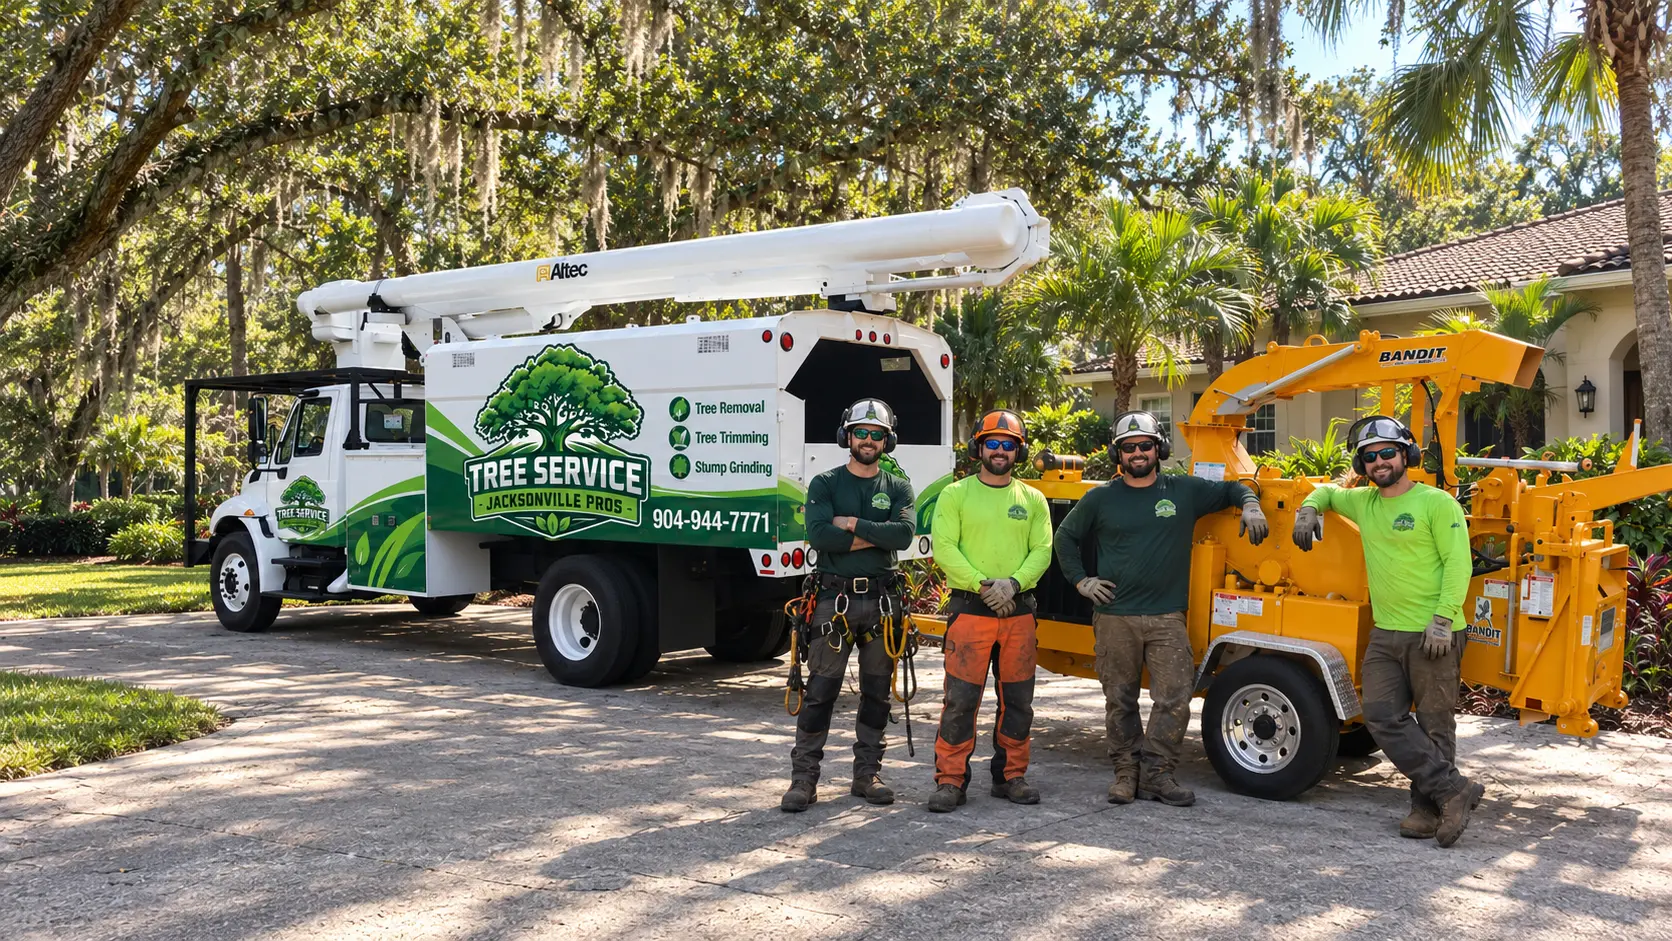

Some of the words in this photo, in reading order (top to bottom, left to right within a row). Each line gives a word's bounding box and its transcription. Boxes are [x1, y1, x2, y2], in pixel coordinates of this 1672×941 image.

[550, 262, 588, 281] Altec
[1379, 347, 1447, 362] BANDIT
[695, 402, 717, 414] Tree
[720, 400, 765, 414] Removal
[695, 431, 717, 443] Tree
[720, 431, 769, 446] Trimming
[469, 457, 527, 493] TREE
[533, 456, 642, 496] SERVICE
[695, 461, 727, 476] Stump
[729, 461, 773, 477] Grinding
[486, 492, 581, 510] JACKSONVILLE
[586, 497, 622, 514] PROS
[277, 508, 296, 520] TREE
[653, 508, 770, 533] 904-944-7771
[1466, 624, 1501, 638] BANDIT
